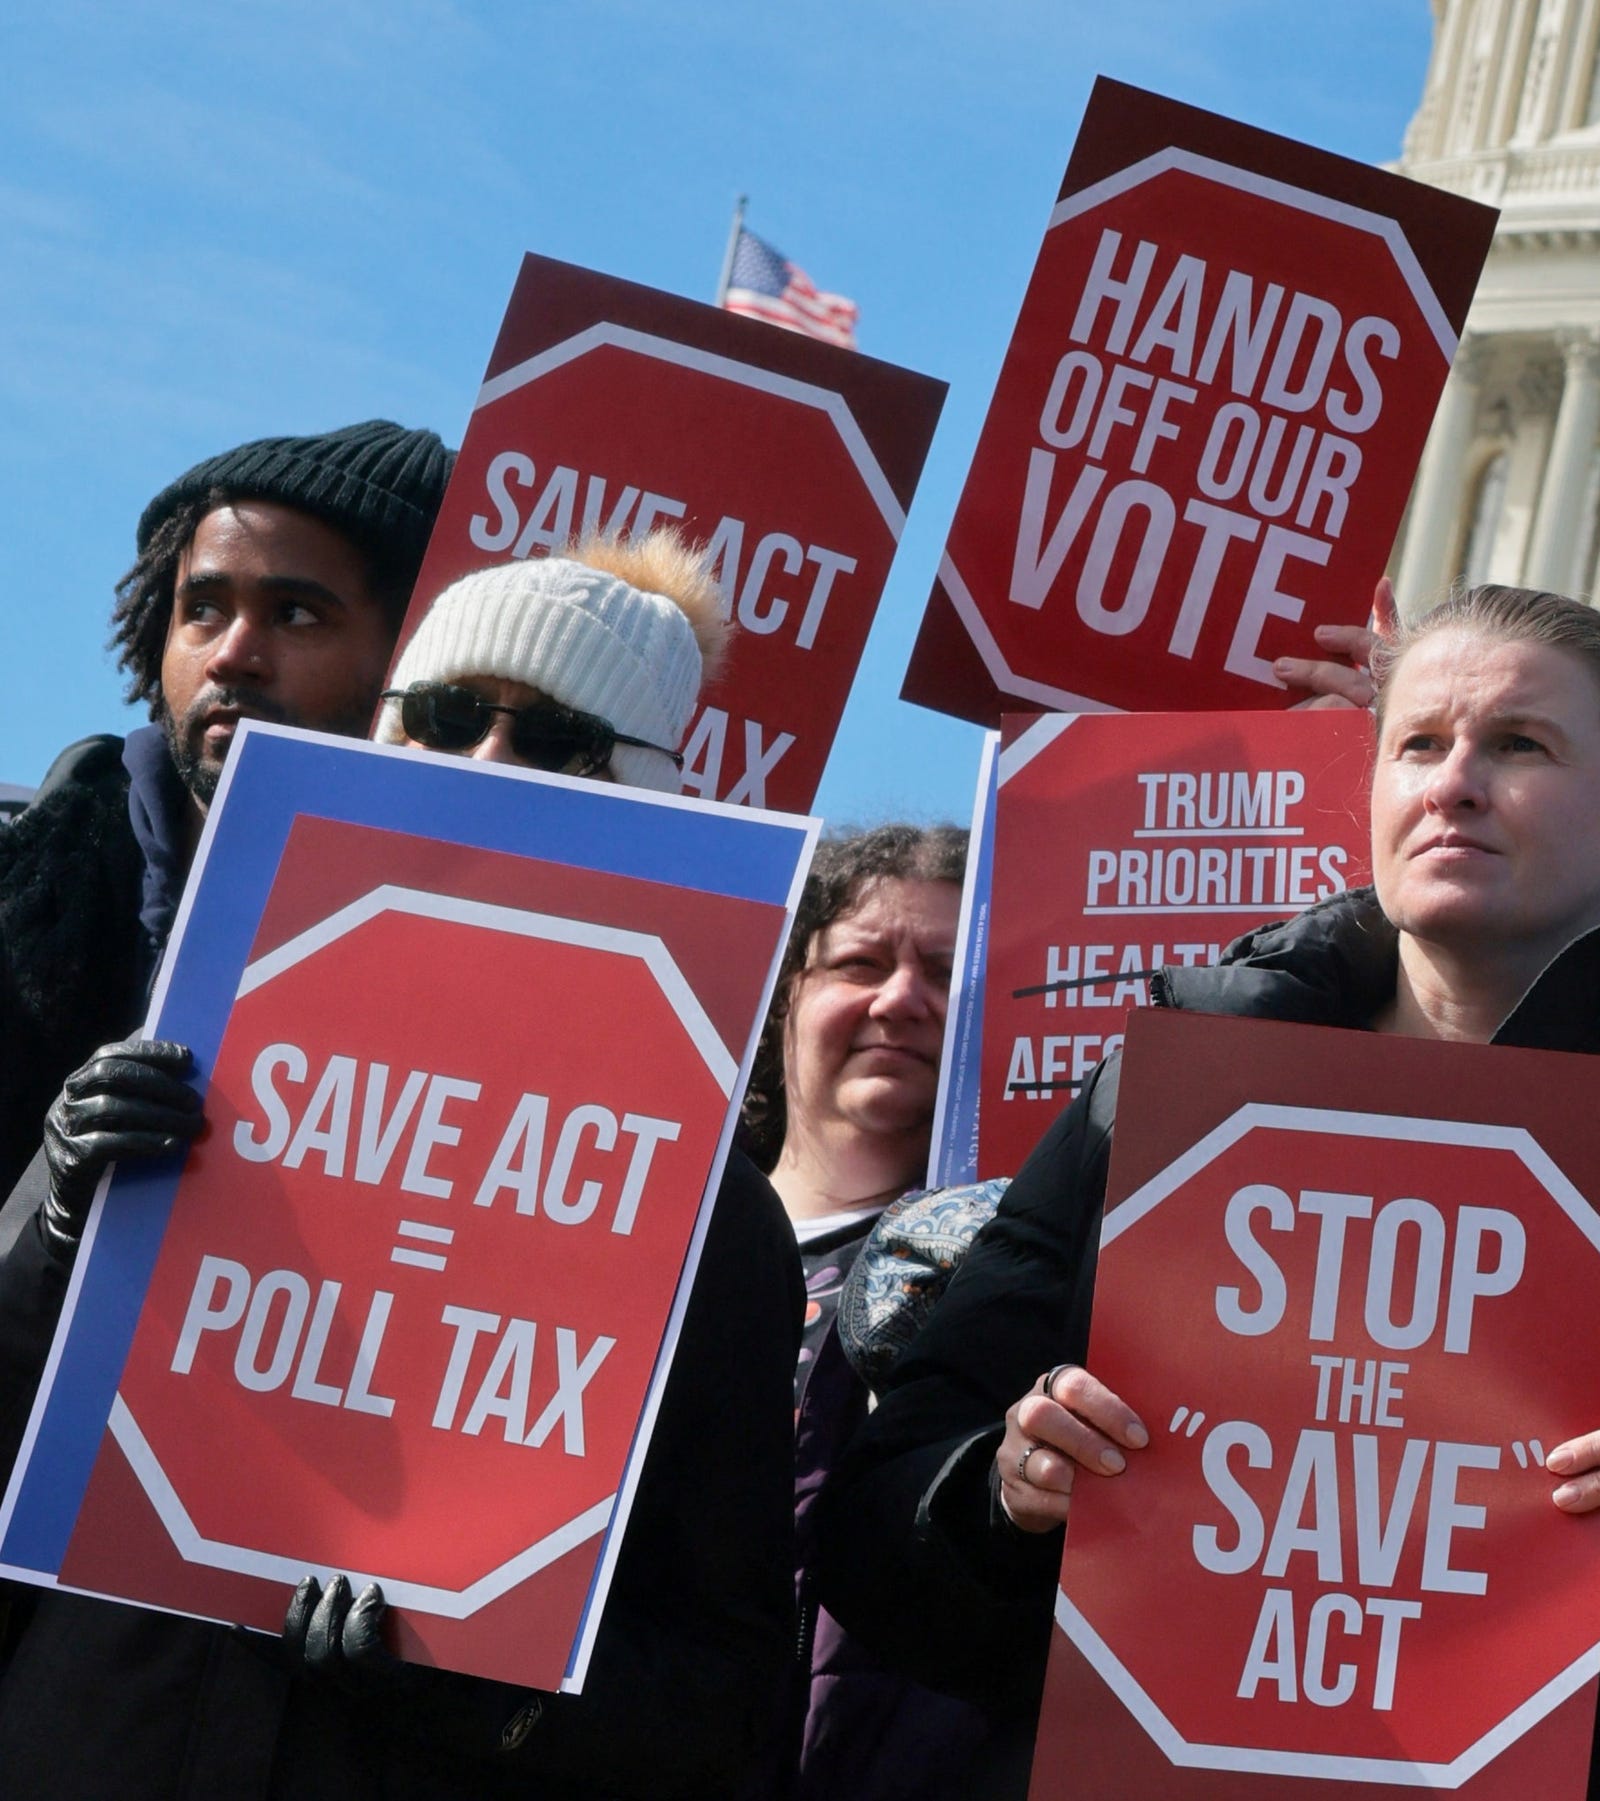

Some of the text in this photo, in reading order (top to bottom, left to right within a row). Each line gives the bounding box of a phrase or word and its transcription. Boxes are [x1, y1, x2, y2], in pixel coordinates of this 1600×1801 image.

[1069, 228, 1401, 433] HANDS
[1039, 350, 1363, 538] OFF OUR
[1009, 447, 1333, 691] VOTE
[681, 703, 797, 809] AX
[1137, 771, 1305, 829] TRUMP
[1088, 846, 1347, 906] PRIORITIES
[234, 1043, 681, 1235] SAVE ACT
[391, 1220, 454, 1271] =
[1215, 1184, 1527, 1354] STOP
[170, 1256, 616, 1457] POLL TAX
[1311, 1355, 1410, 1428] THE
[1237, 1588, 1422, 1711] ACT
